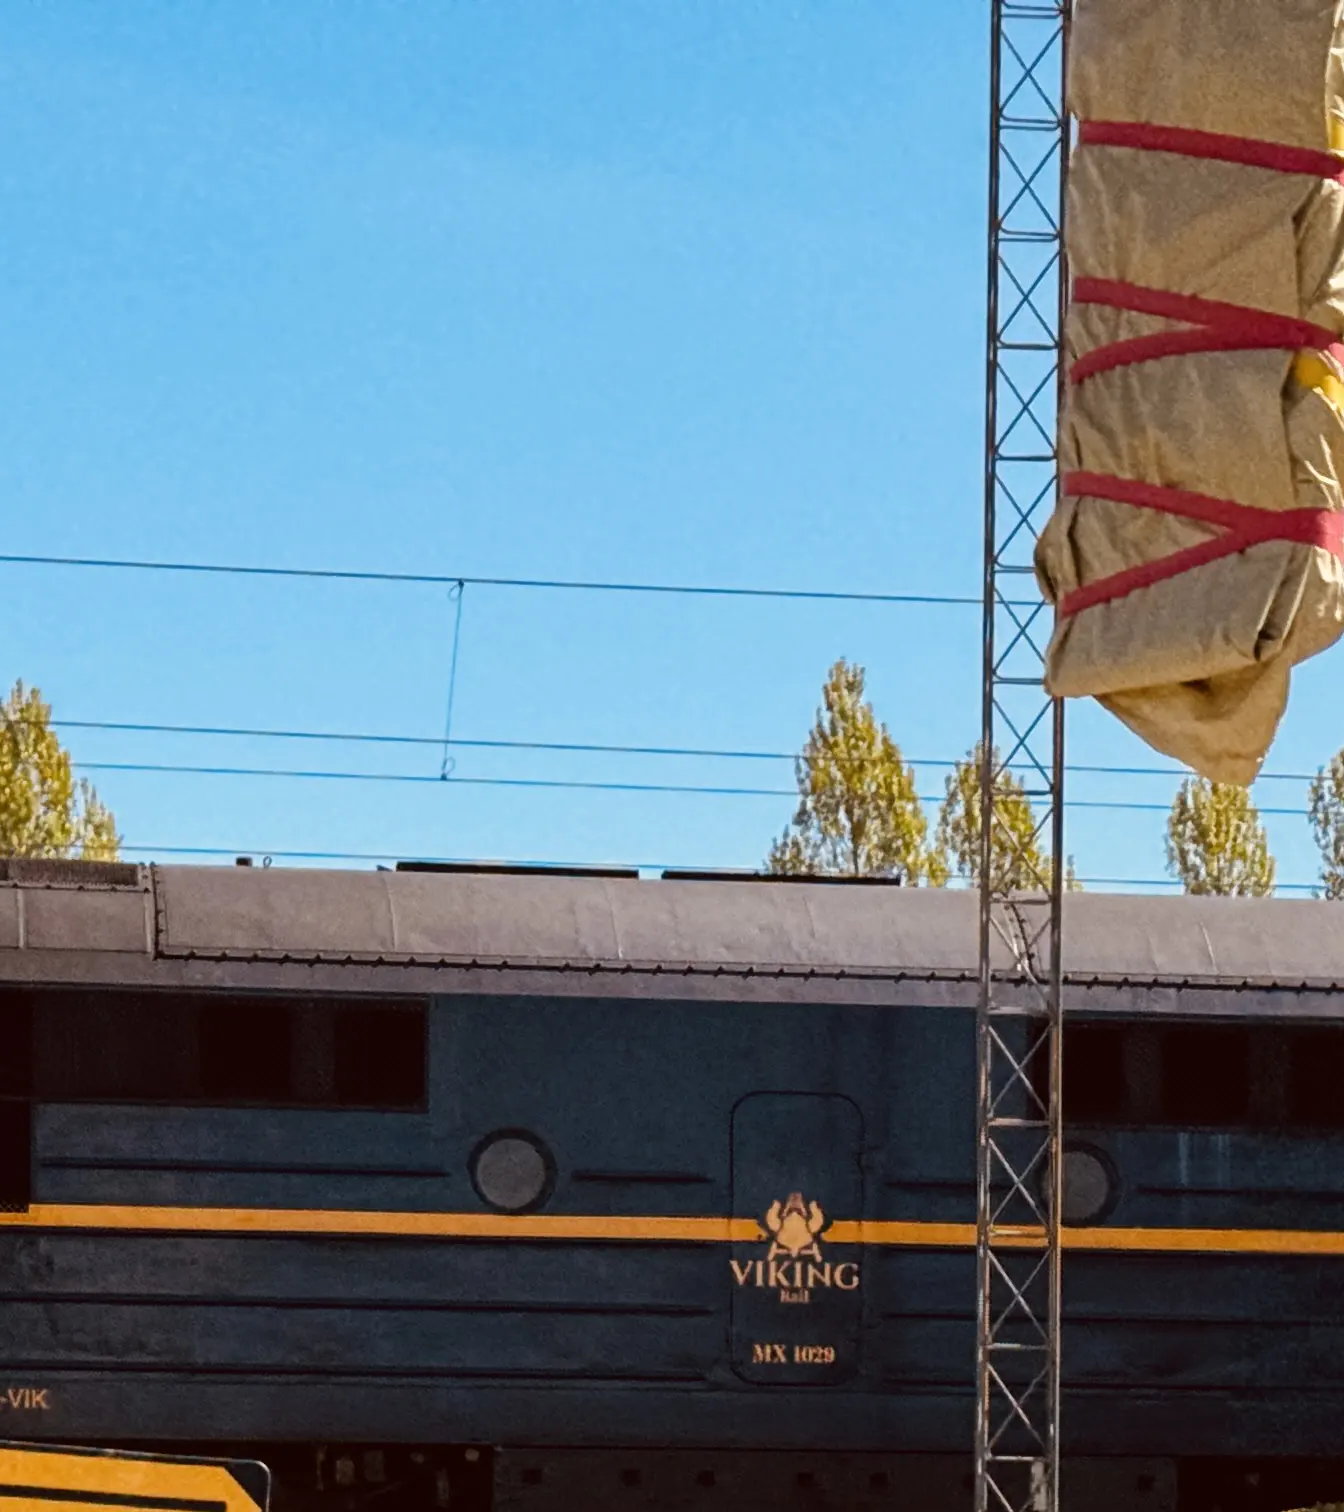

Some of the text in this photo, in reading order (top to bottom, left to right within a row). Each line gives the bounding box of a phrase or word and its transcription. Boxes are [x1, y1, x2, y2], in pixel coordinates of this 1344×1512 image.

[729, 1260, 859, 1290] VIKING
[752, 1344, 835, 1363] MX 1029
